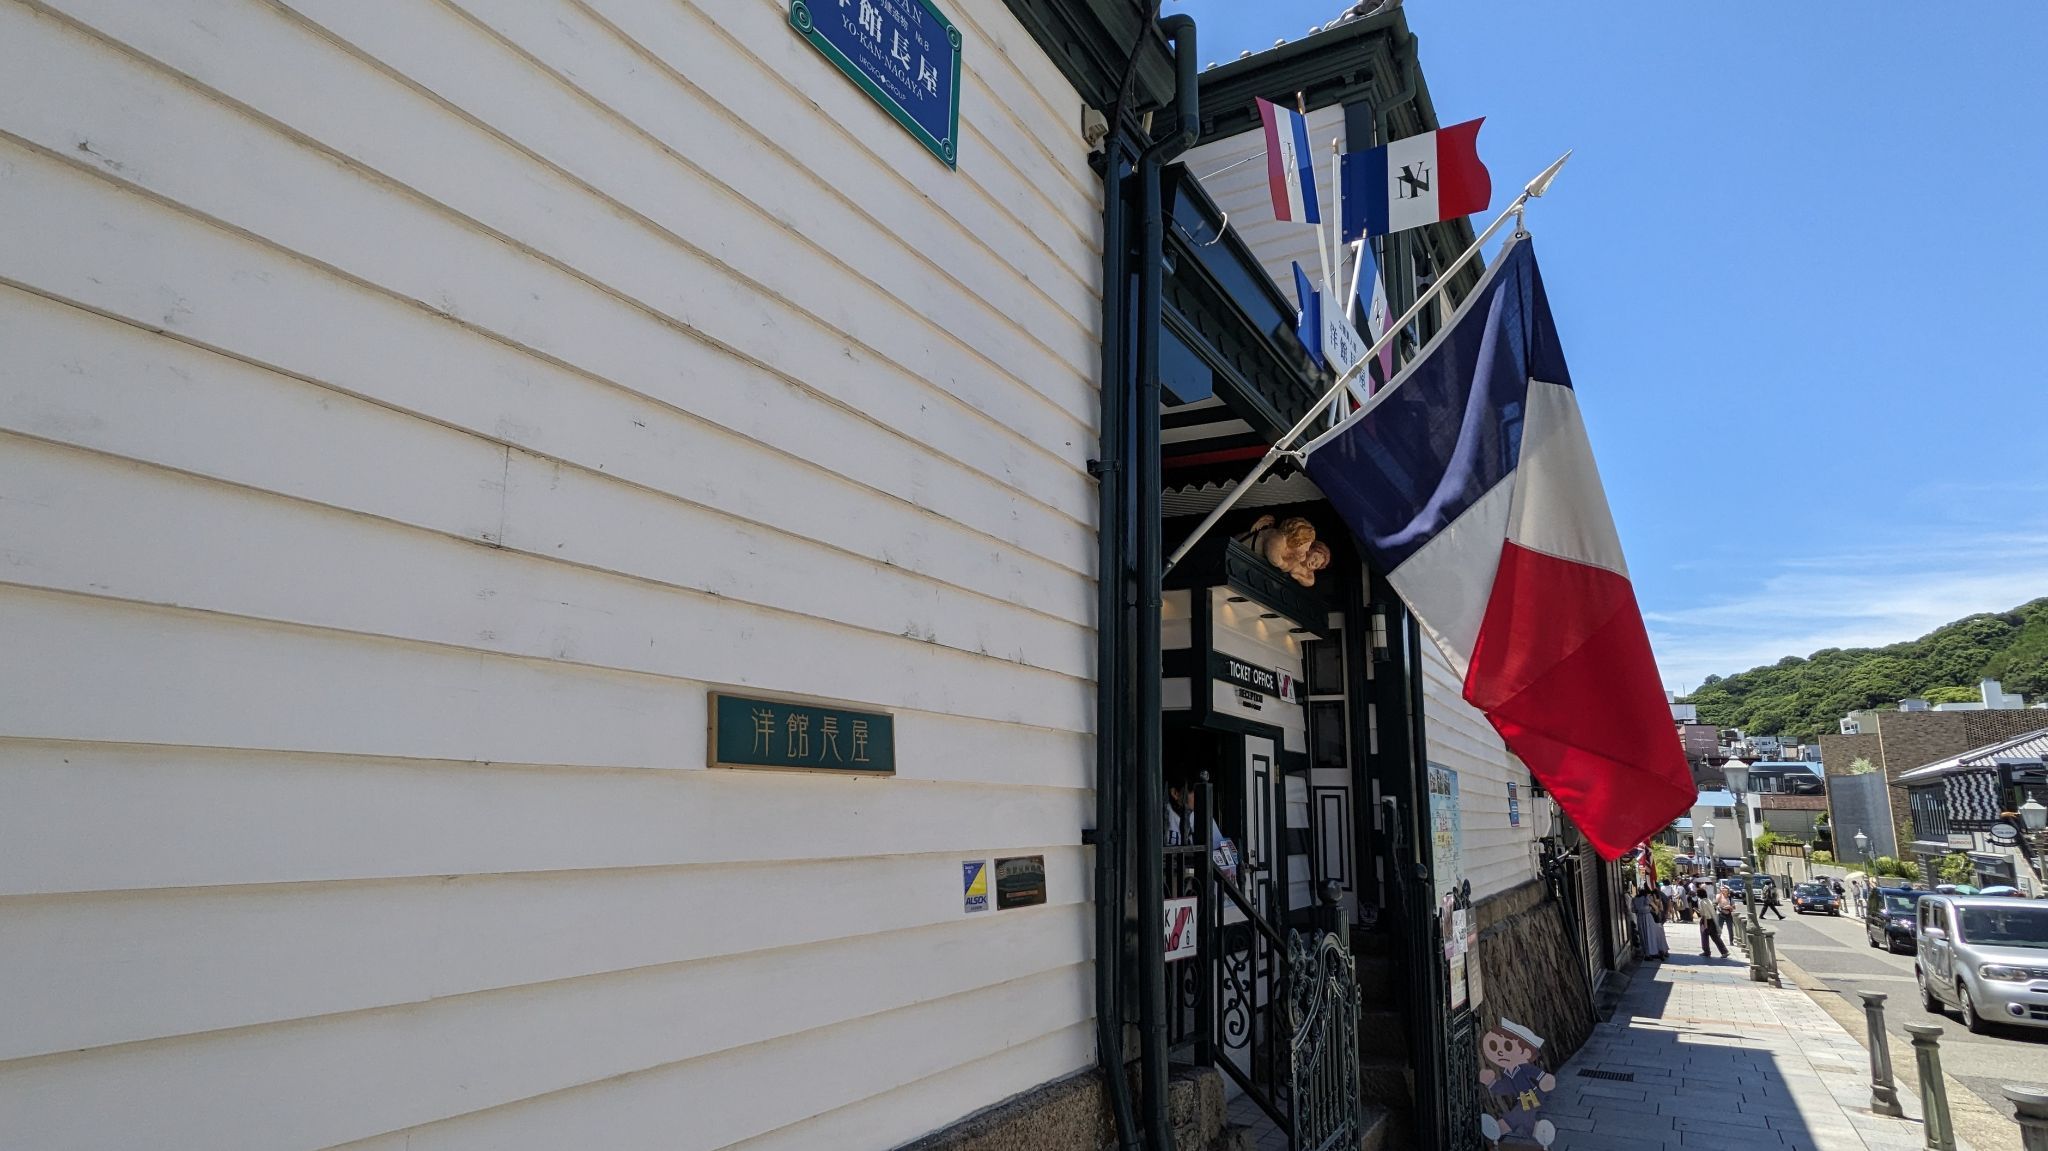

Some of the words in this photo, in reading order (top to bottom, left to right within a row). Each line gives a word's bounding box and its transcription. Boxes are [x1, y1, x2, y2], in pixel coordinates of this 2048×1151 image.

[839, 0, 938, 98] 館長屋
[1229, 660, 1251, 682] TICKET
[1252, 670, 1274, 690] OFFICE
[751, 707, 870, 762] 洋館長屋
[965, 895, 987, 905] ALSOK
